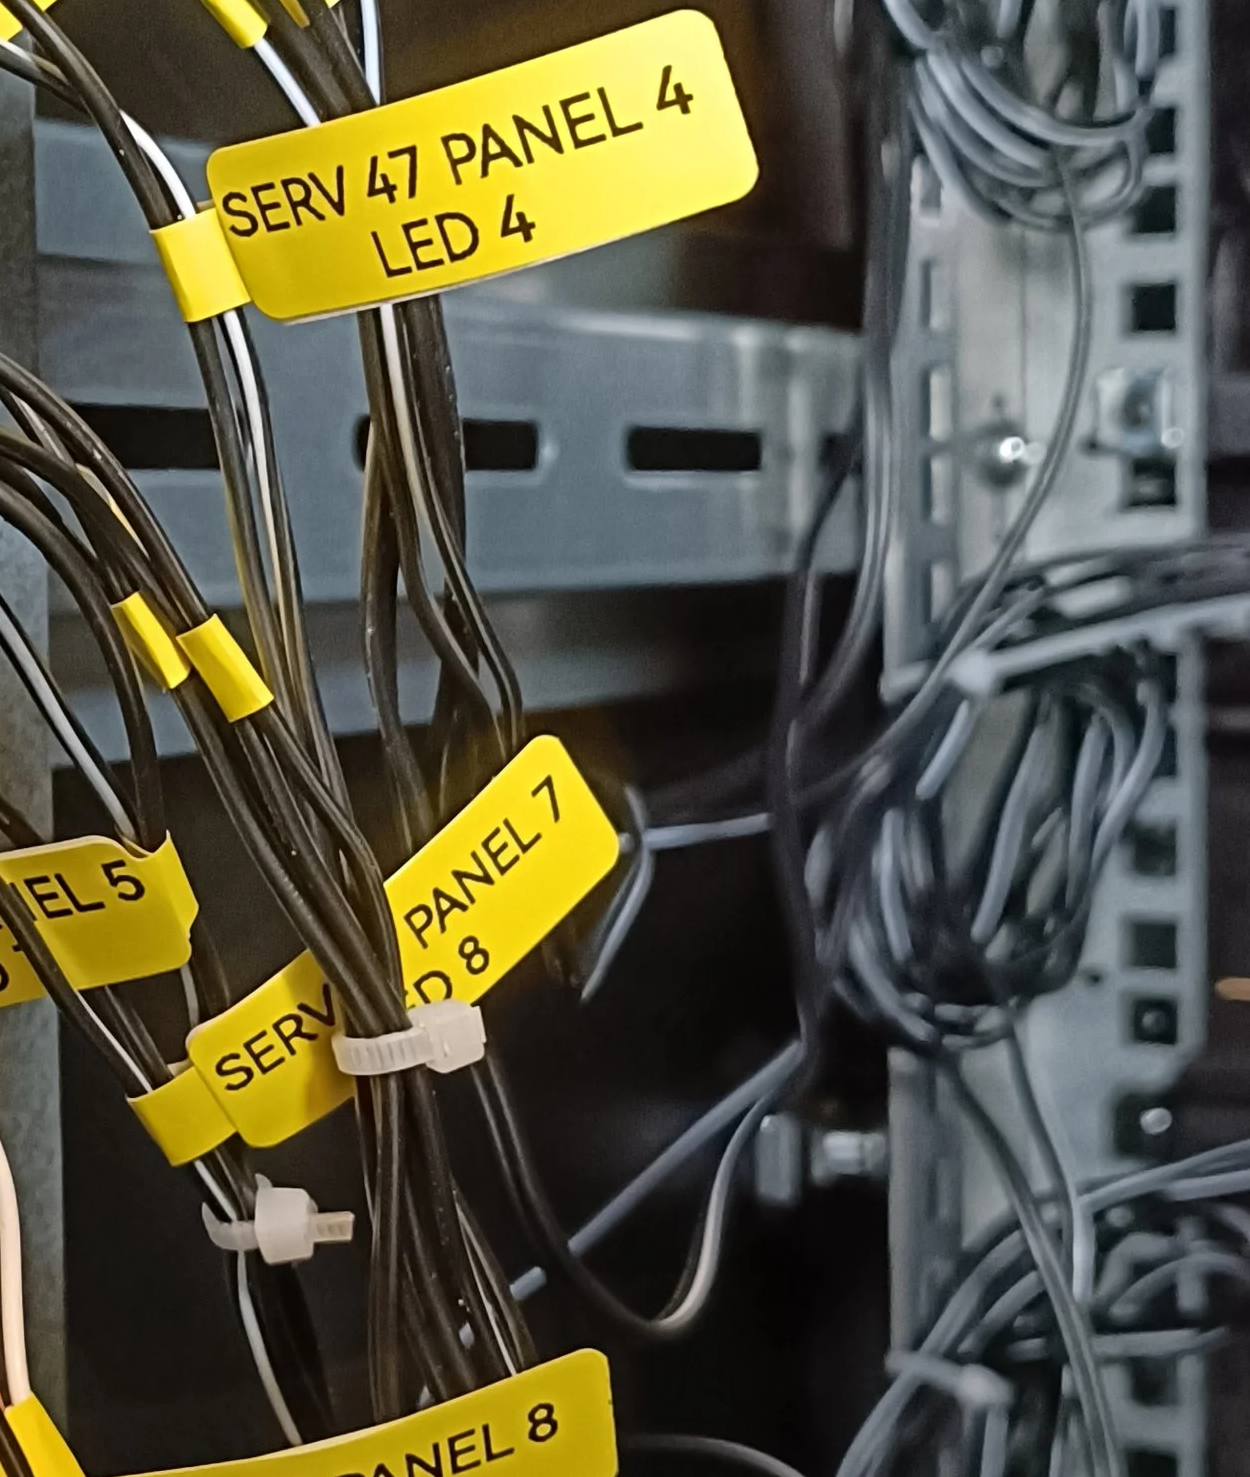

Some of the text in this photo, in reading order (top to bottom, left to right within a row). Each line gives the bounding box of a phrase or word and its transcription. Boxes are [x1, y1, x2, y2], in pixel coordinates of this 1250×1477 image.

[222, 64, 693, 237] SERV 47 PANEL 4
[372, 193, 537, 278] LED 4
[102, 860, 145, 902] 5
[215, 774, 561, 1091] SERV PANEL 7
[457, 935, 490, 976] 8
[525, 1403, 560, 1446] 8
